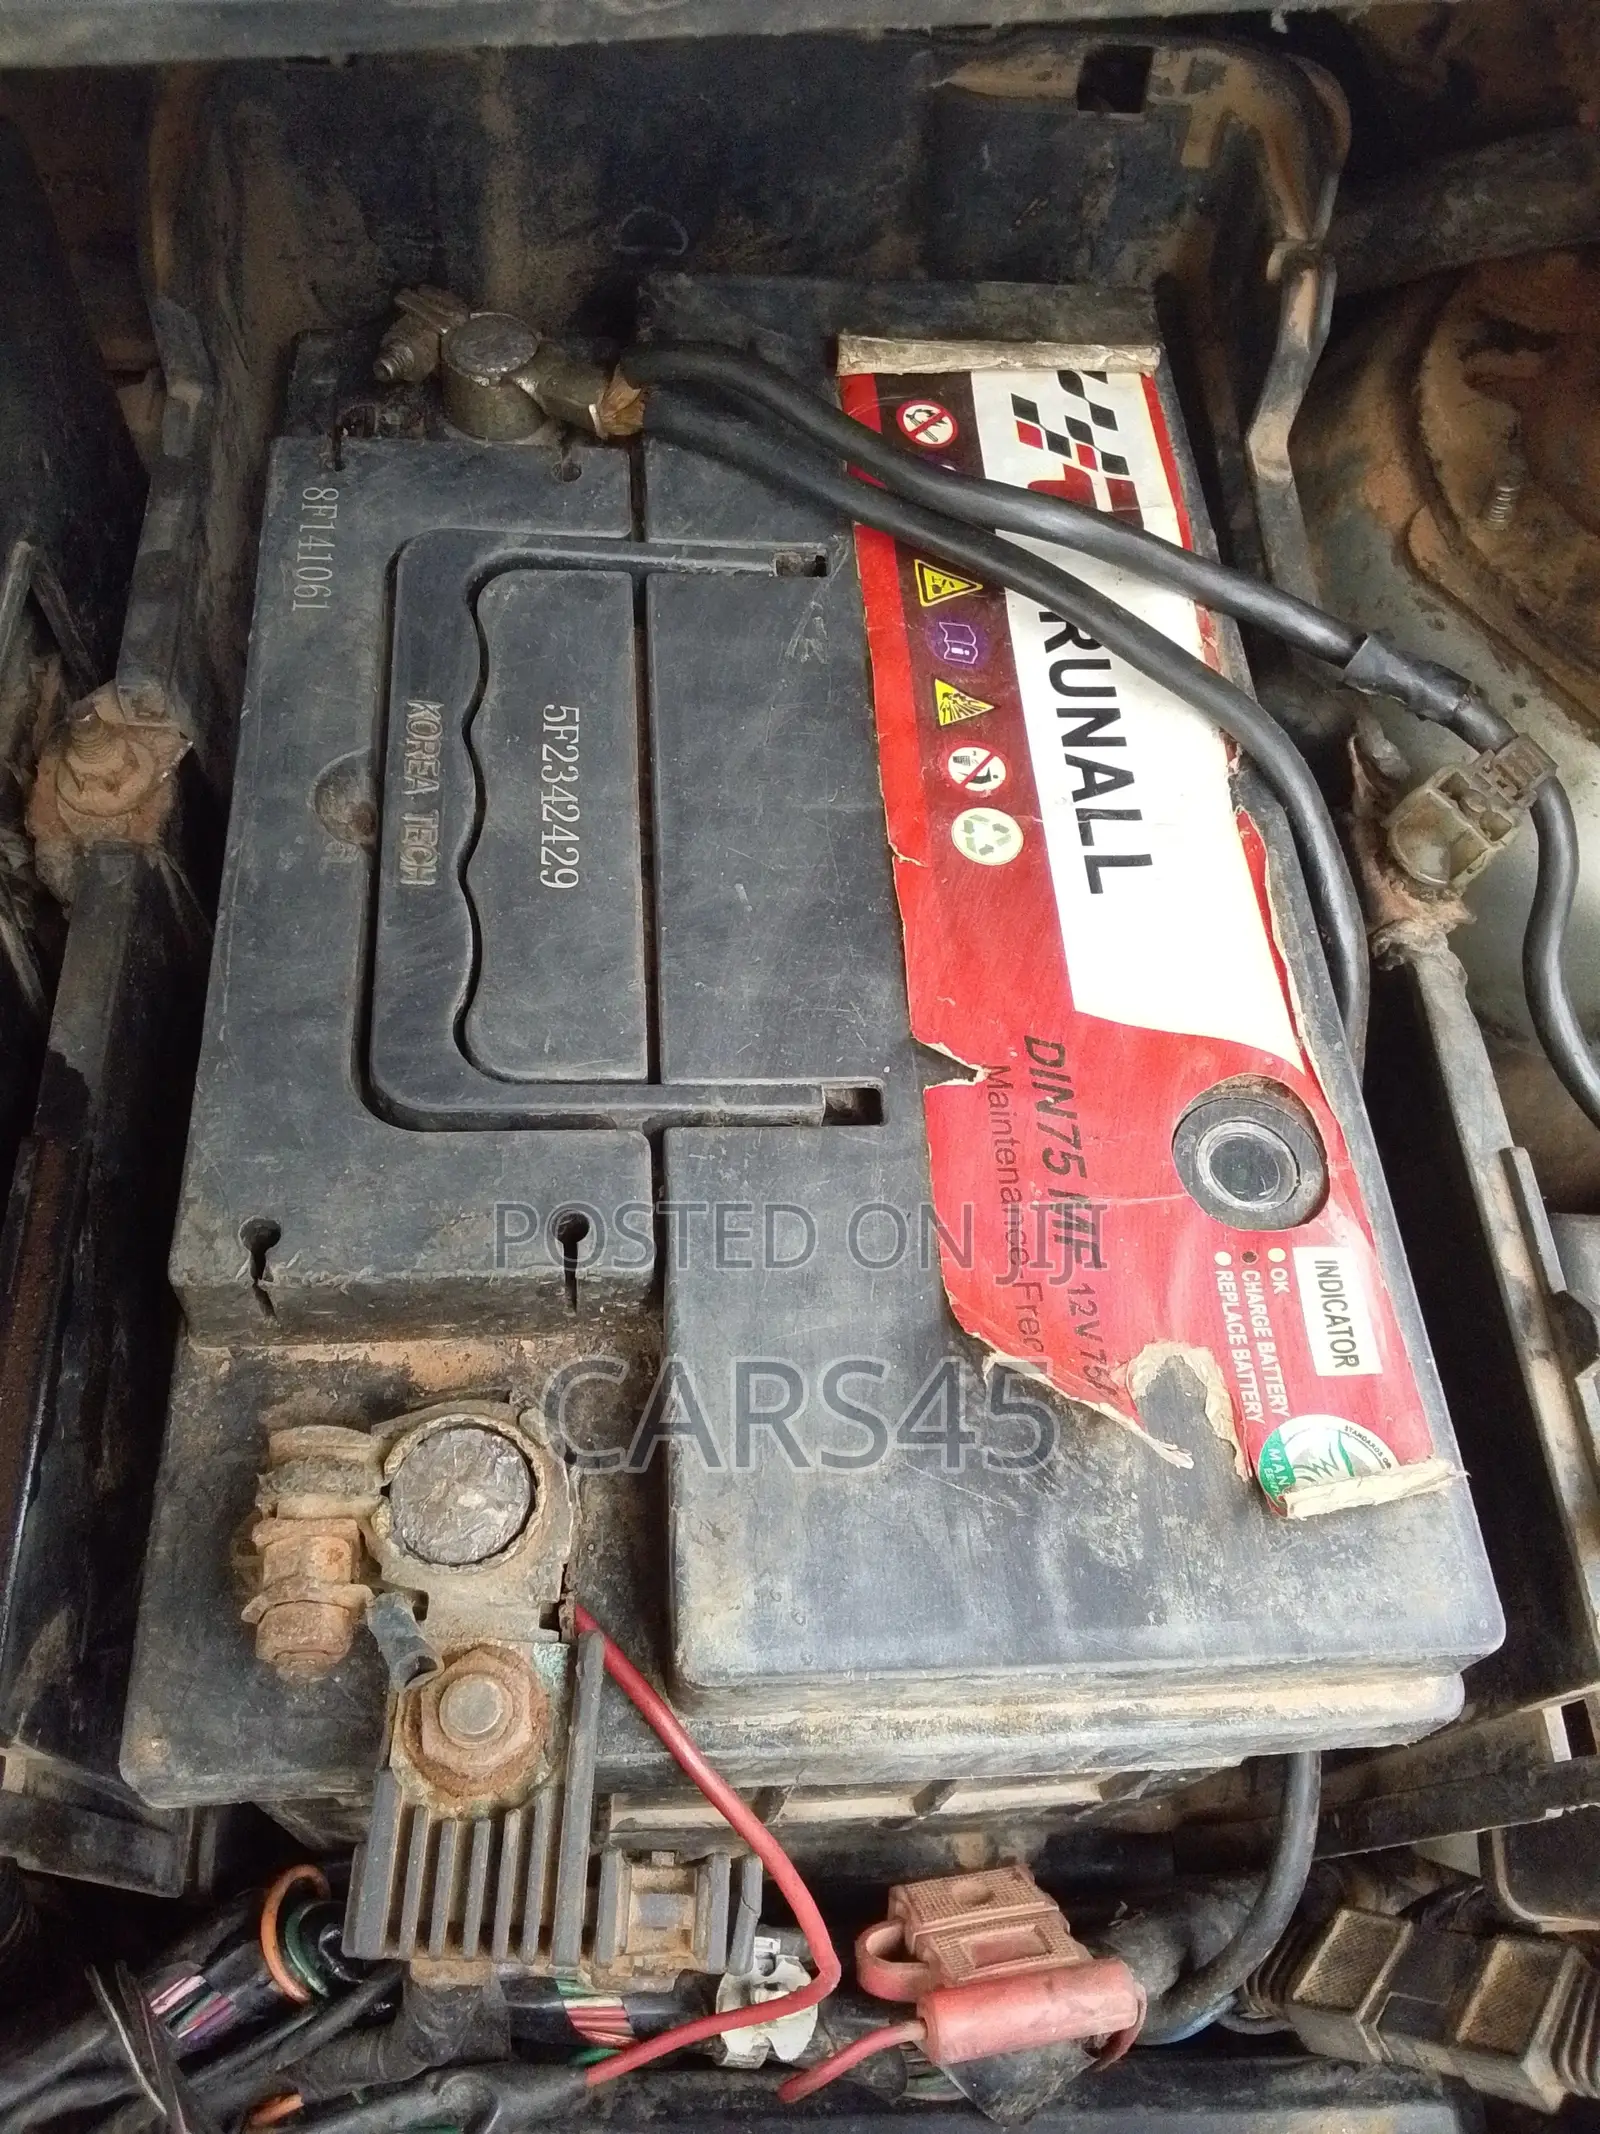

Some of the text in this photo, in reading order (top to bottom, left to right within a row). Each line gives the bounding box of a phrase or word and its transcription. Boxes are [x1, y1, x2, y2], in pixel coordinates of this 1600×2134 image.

[292, 487, 339, 612] 8F141061
[400, 699, 444, 886] KOREA TECH
[539, 703, 581, 889] 5F2342429
[1068, 1282, 1104, 1343] 12V
[1214, 1270, 1266, 1425] REPLACE BATTERY
[1241, 1269, 1291, 1418] CHARGE BATTERY
[1269, 1267, 1291, 1295] OK
[1314, 1260, 1360, 1369] INDICATOR
